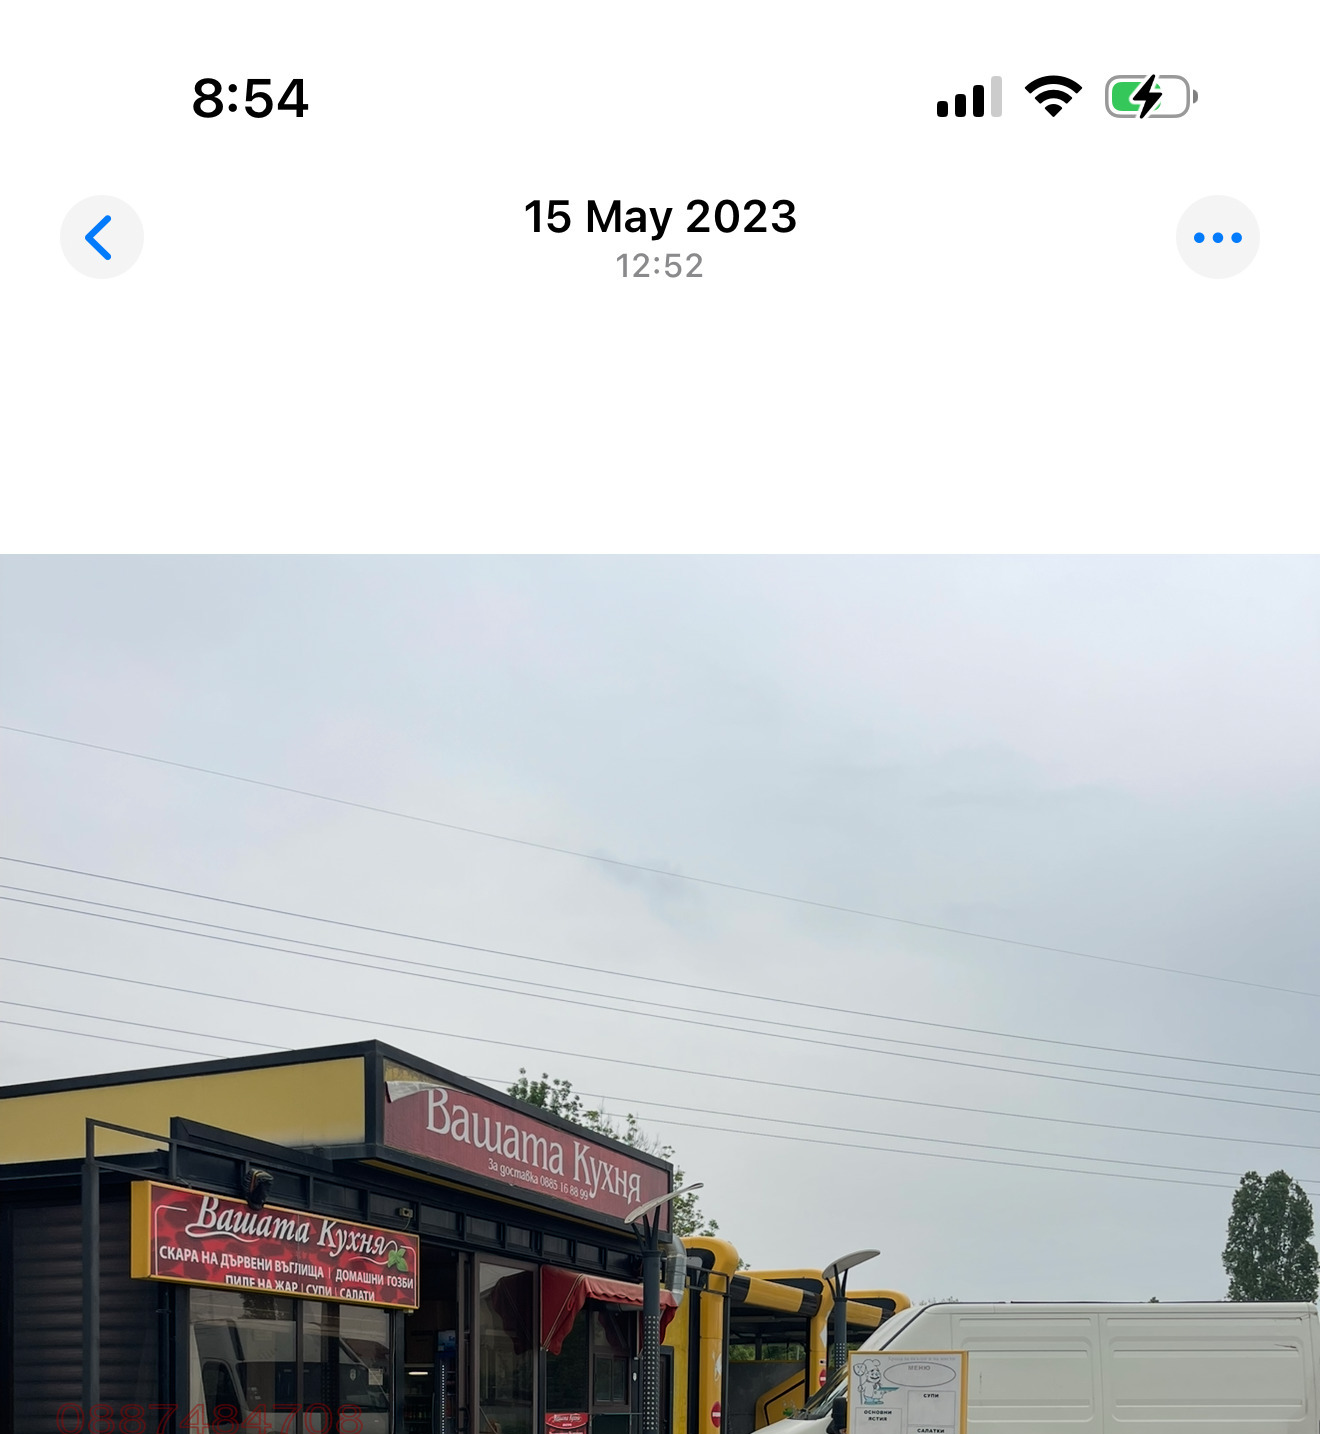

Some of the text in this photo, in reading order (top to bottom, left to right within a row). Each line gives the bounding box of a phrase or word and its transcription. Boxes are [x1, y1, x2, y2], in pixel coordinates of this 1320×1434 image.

[193, 78, 308, 118] 8:54
[526, 199, 796, 241] 15 May 2023
[617, 253, 702, 278] 12:52
[426, 1087, 642, 1205] Вашата Кухня
[488, 1158, 498, 1171] За
[540, 1175, 558, 1190] 0885
[560, 1182, 569, 1194] 16
[570, 1185, 579, 1197] 88
[580, 1188, 589, 1200] 99
[188, 1195, 386, 1257] Вашата Кухня
[159, 1245, 414, 1290] СКАРА НА ДЪРВЕНИ ВЪГЛИЩА ДОМАШНИ ГОЗБИ
[258, 1278, 273, 1289] НА
[275, 1280, 299, 1293] ЖАР
